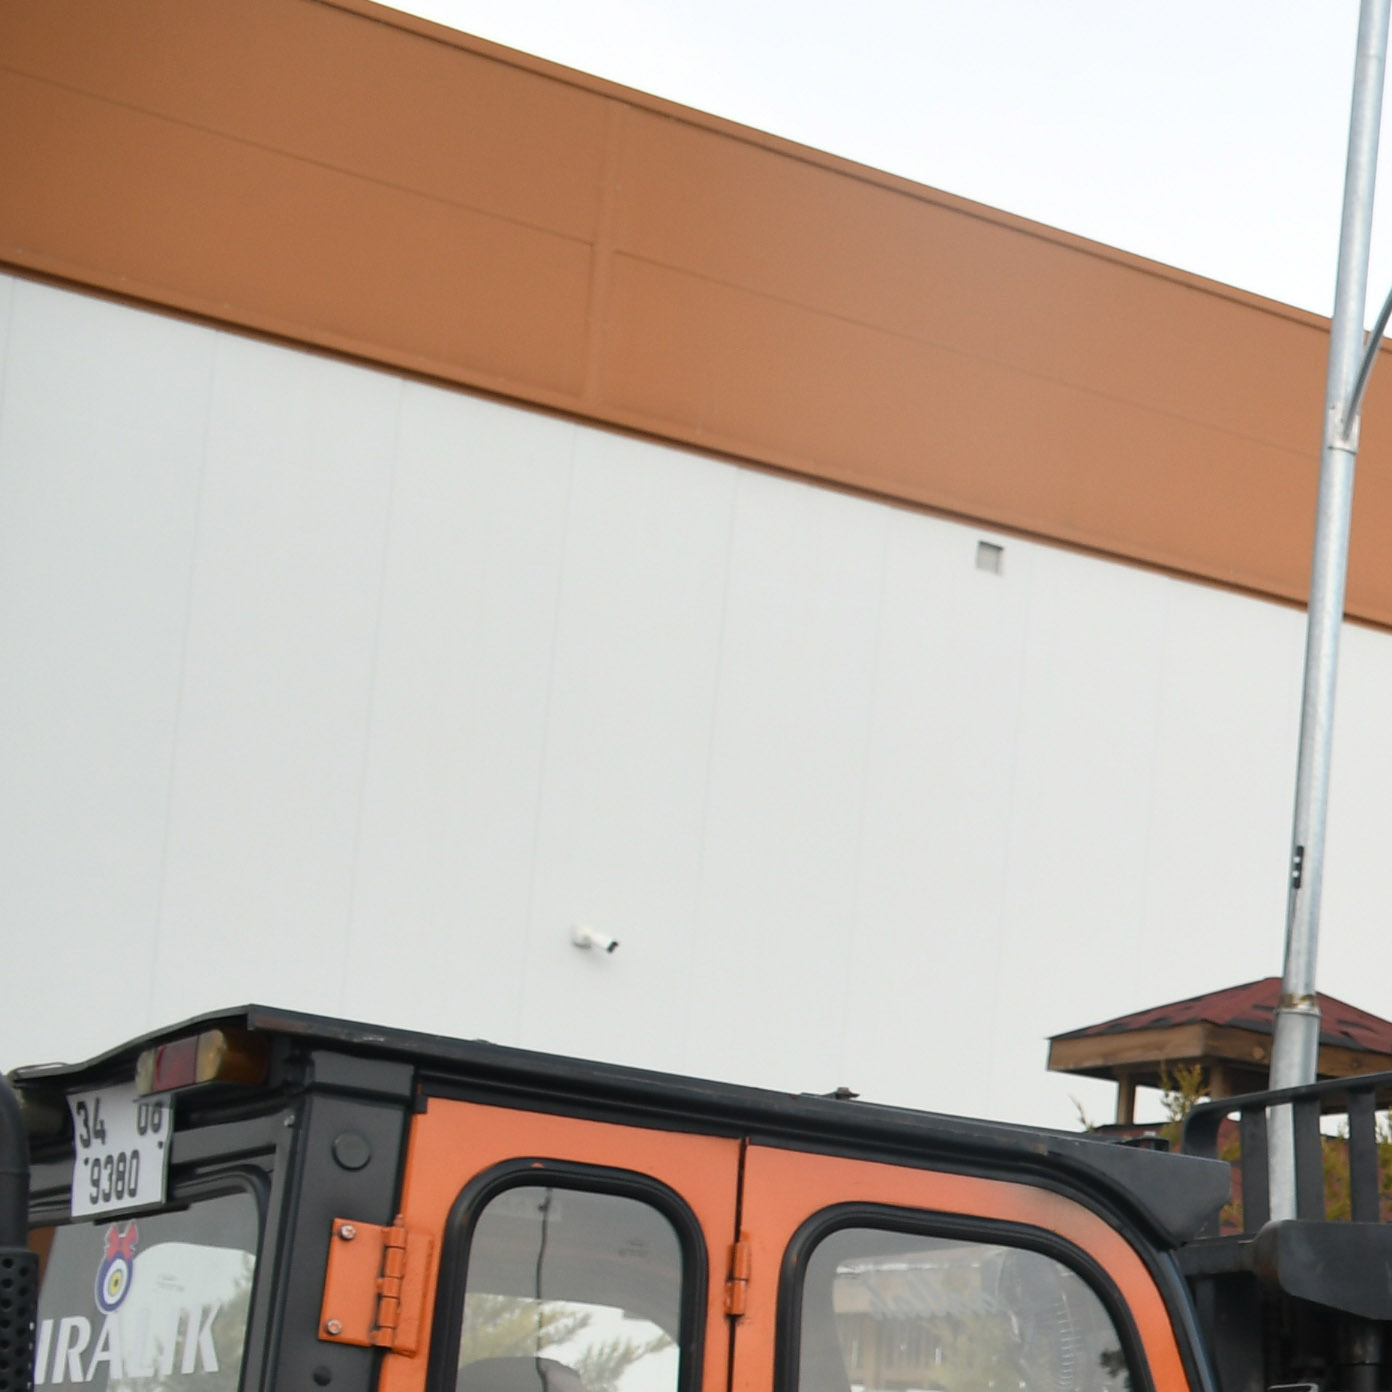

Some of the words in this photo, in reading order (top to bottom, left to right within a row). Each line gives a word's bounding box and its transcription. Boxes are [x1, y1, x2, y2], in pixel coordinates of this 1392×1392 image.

[76, 1098, 106, 1148] 34
[90, 1150, 140, 1204] 9380
[34, 1303, 219, 1385] IRALIK
